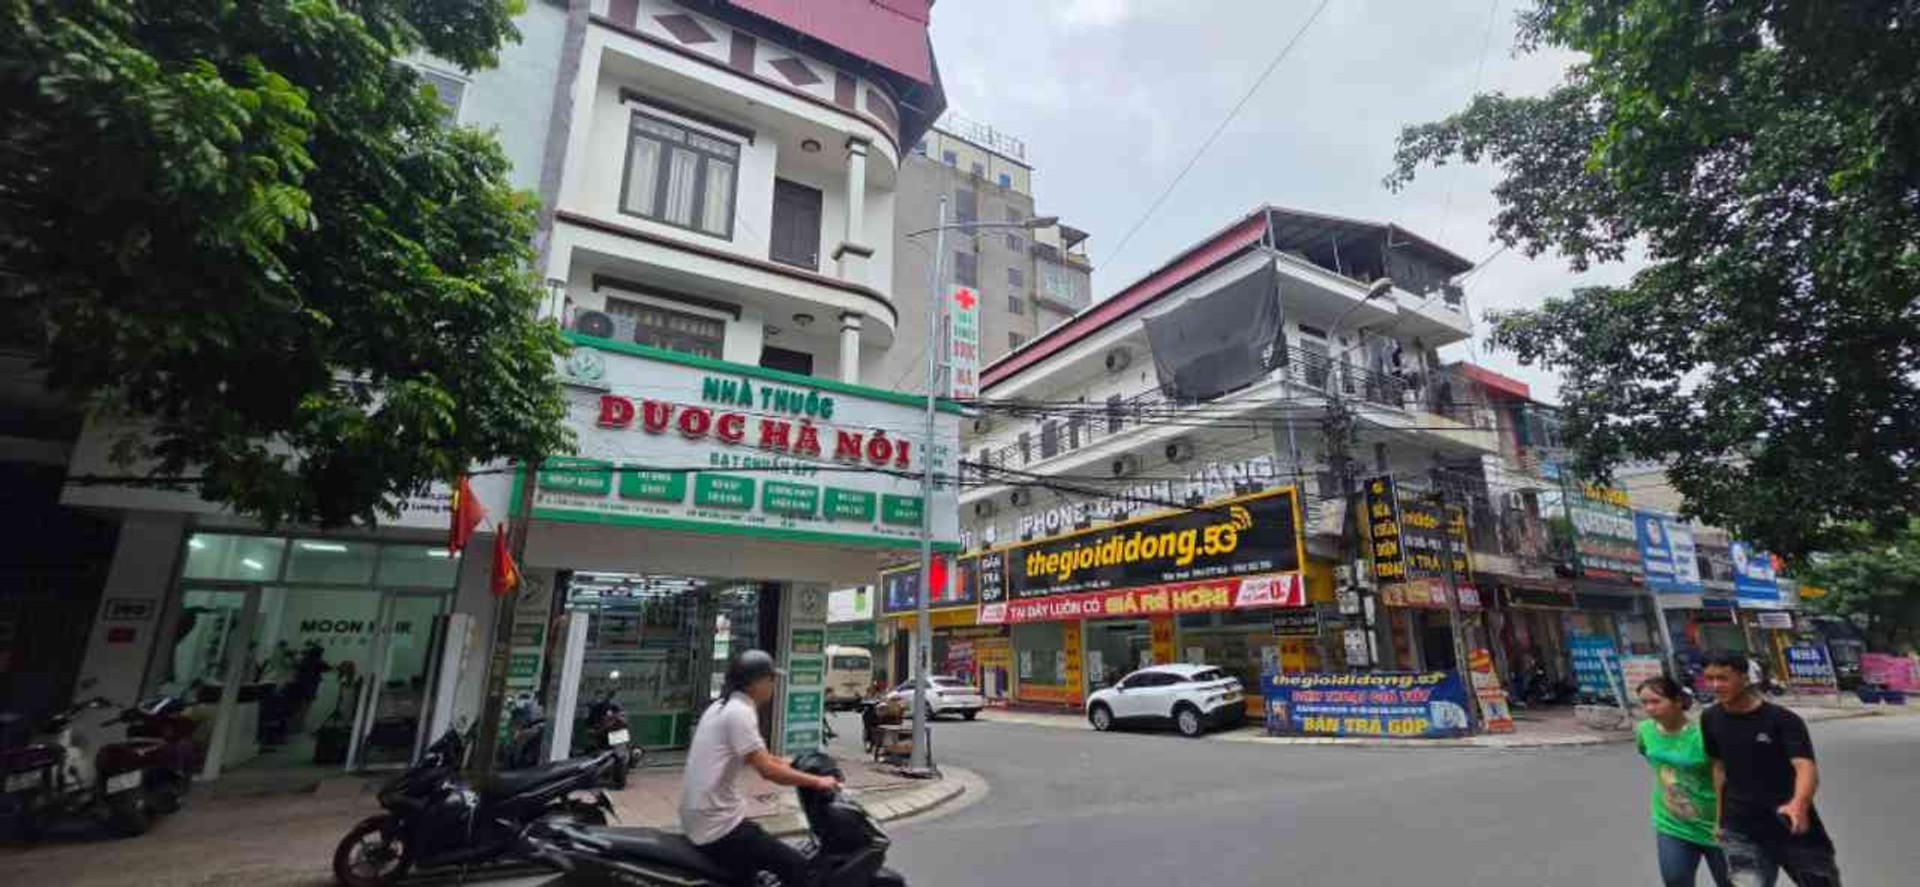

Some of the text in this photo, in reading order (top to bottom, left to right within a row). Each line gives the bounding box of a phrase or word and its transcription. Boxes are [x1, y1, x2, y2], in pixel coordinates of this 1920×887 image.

[703, 376, 834, 420] NHÀ THUỐC
[758, 417, 822, 457] HÀ
[301, 619, 363, 633] MOON
